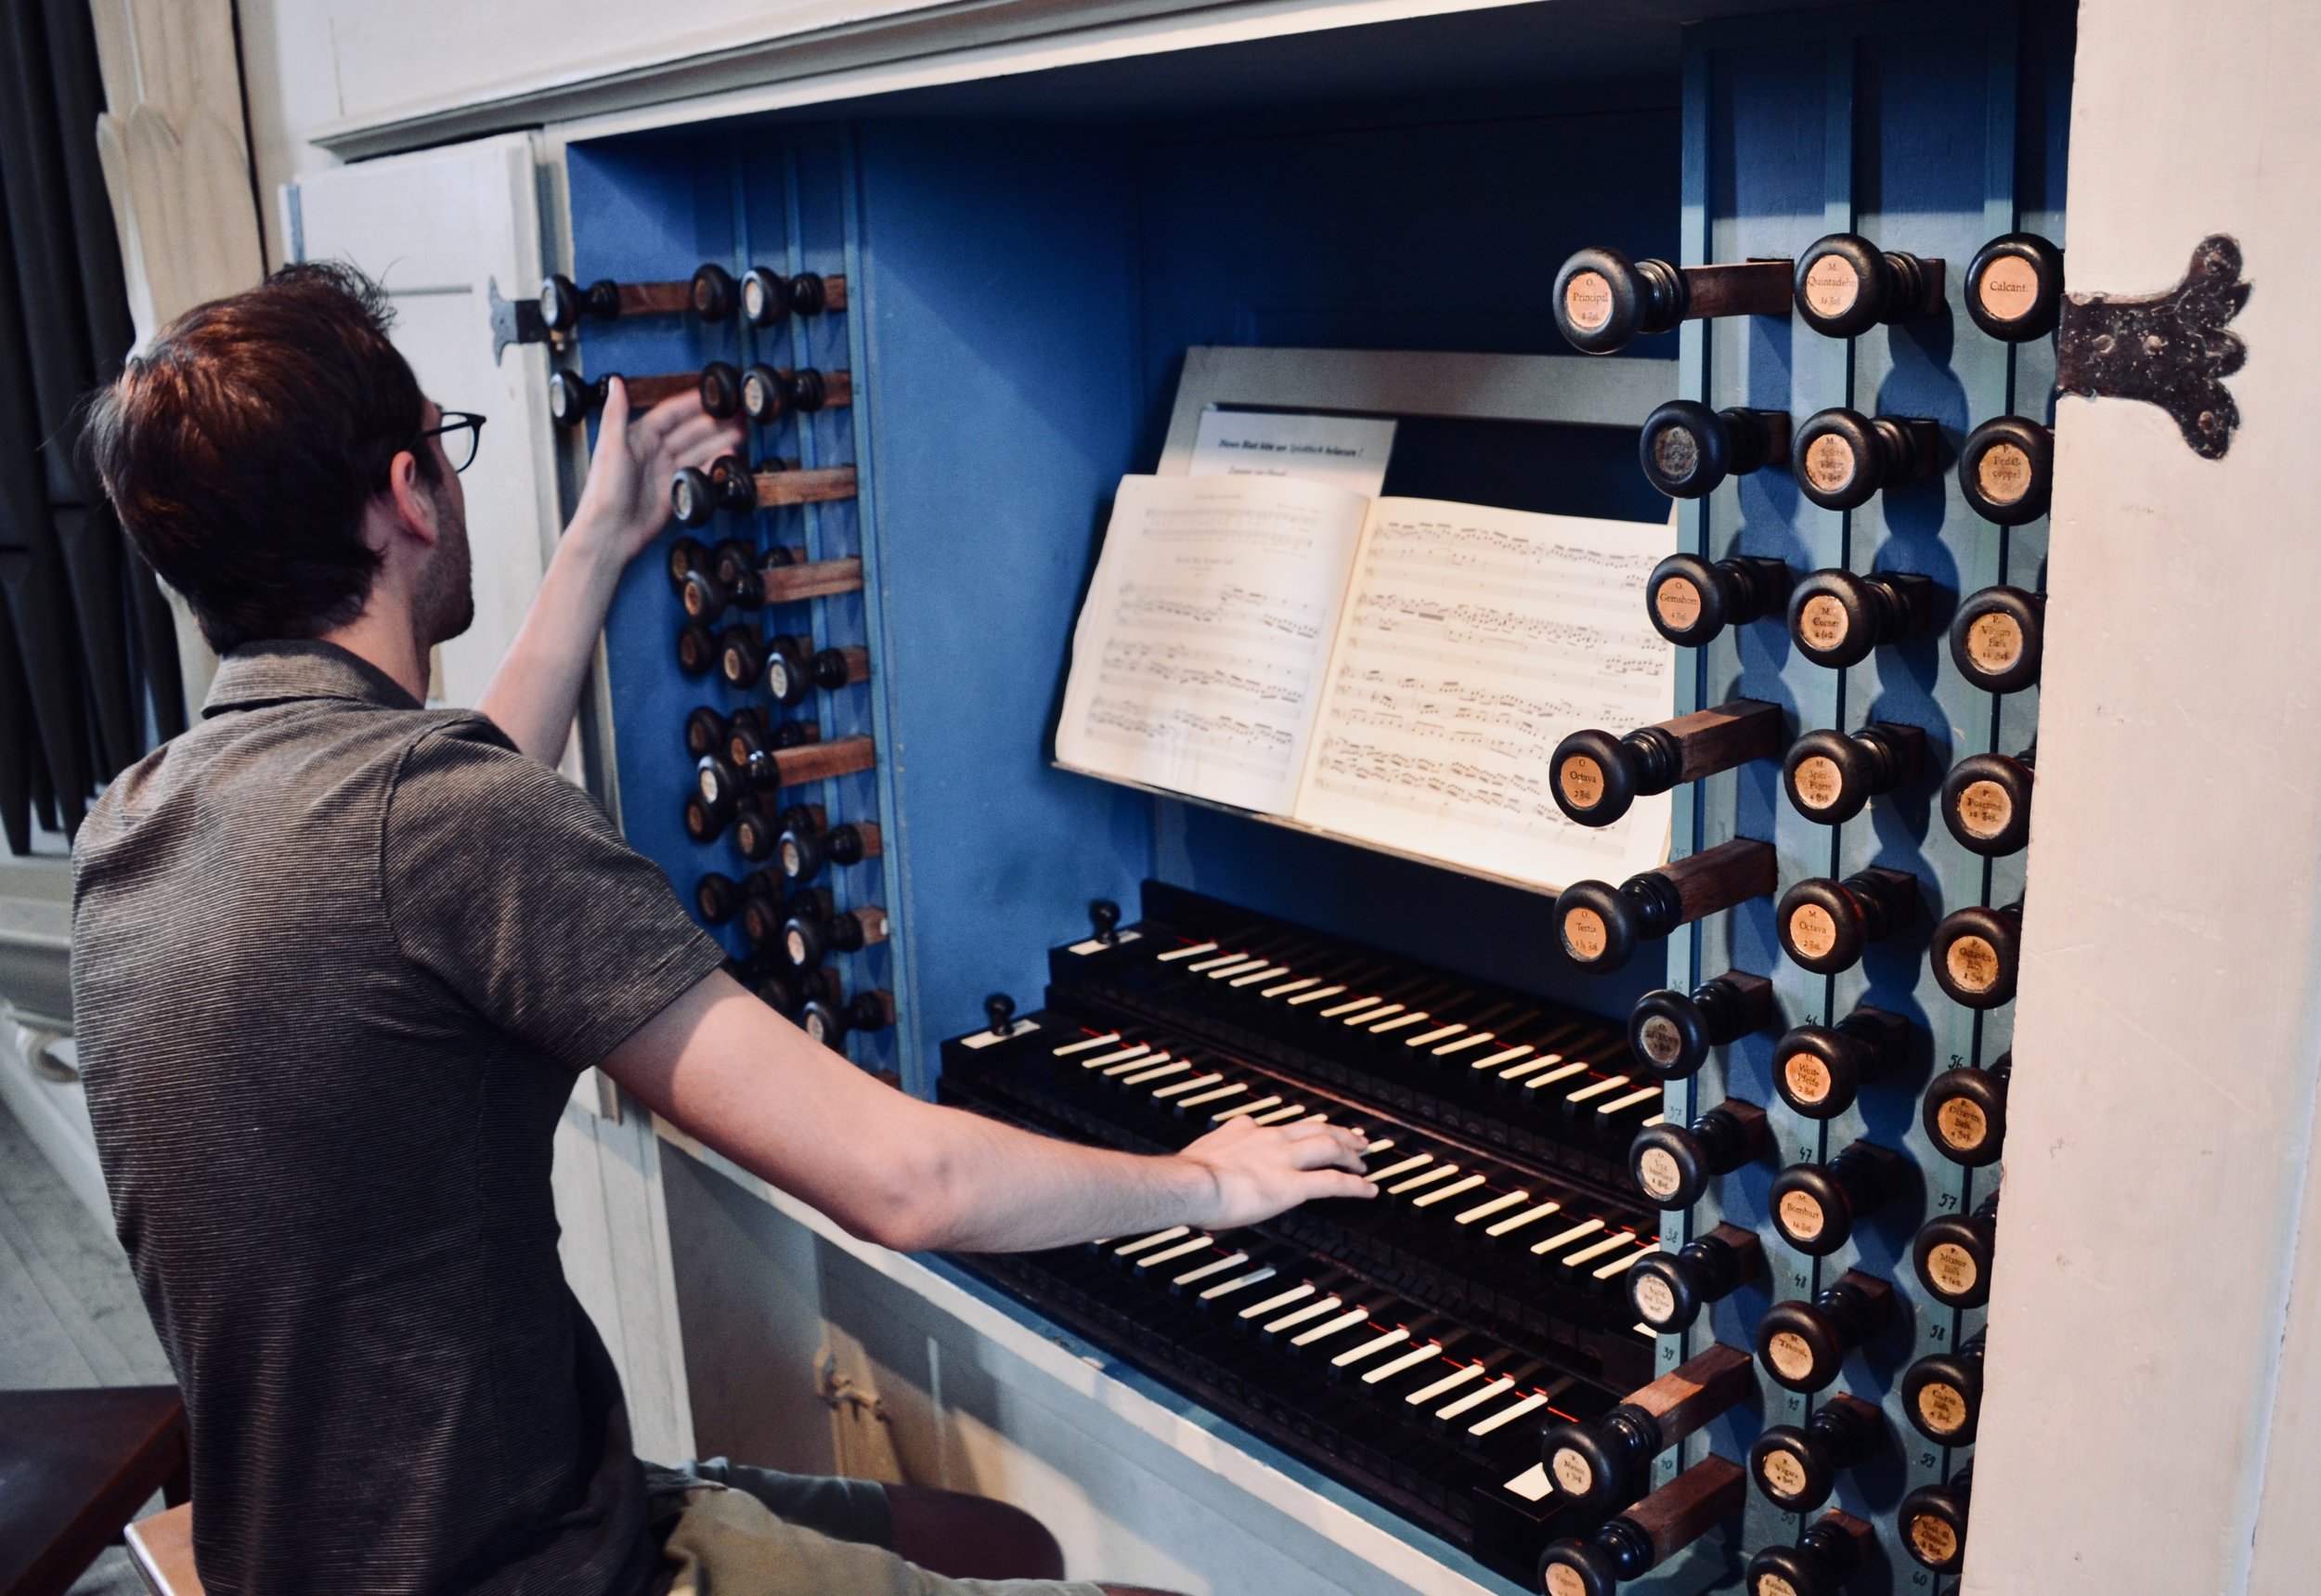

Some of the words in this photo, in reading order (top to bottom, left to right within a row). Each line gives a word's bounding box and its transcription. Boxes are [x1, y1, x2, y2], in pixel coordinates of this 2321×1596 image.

[1990, 280, 2029, 292] Calcant.
[1573, 292, 1608, 305] Principal
[1570, 771, 1597, 783] Octava
[1799, 921, 1827, 934] Octava
[1938, 1192, 1957, 1211] 57
[1929, 1324, 1946, 1342] 58
[1913, 1571, 1928, 1587] 60
